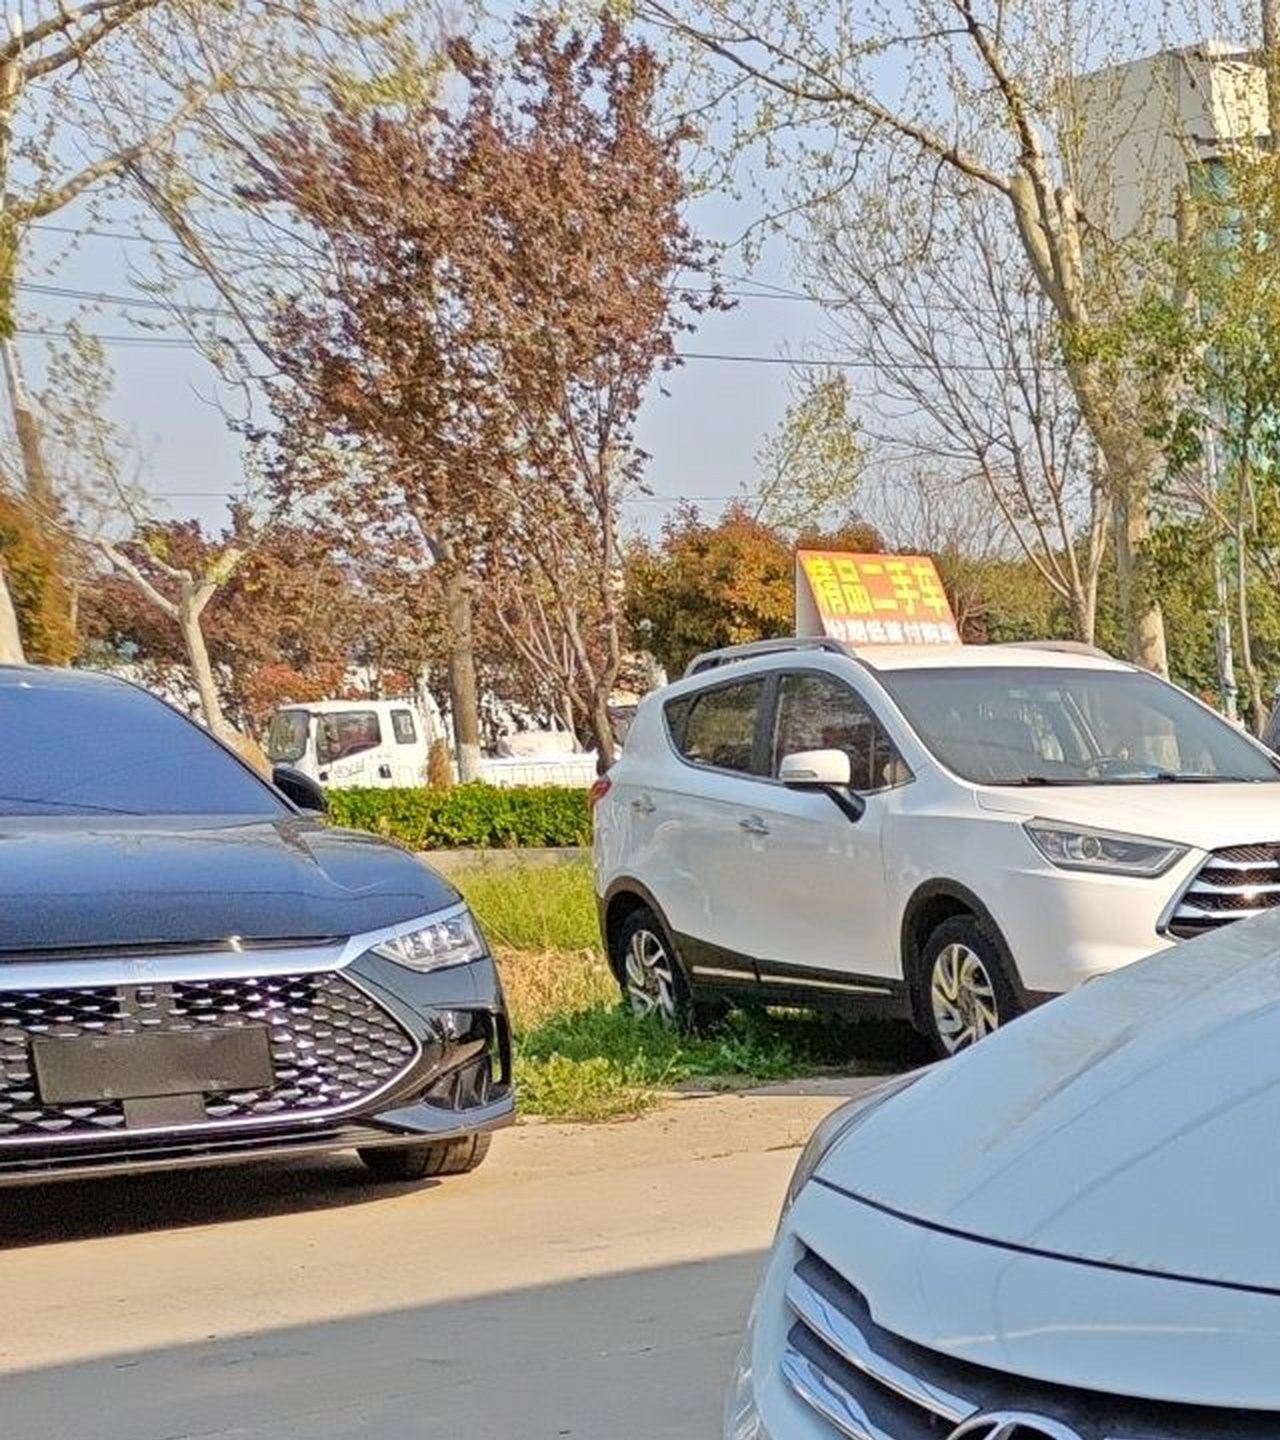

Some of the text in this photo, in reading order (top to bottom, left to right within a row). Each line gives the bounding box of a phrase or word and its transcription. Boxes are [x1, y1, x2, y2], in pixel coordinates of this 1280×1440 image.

[806, 556, 945, 617] 精品二手车
